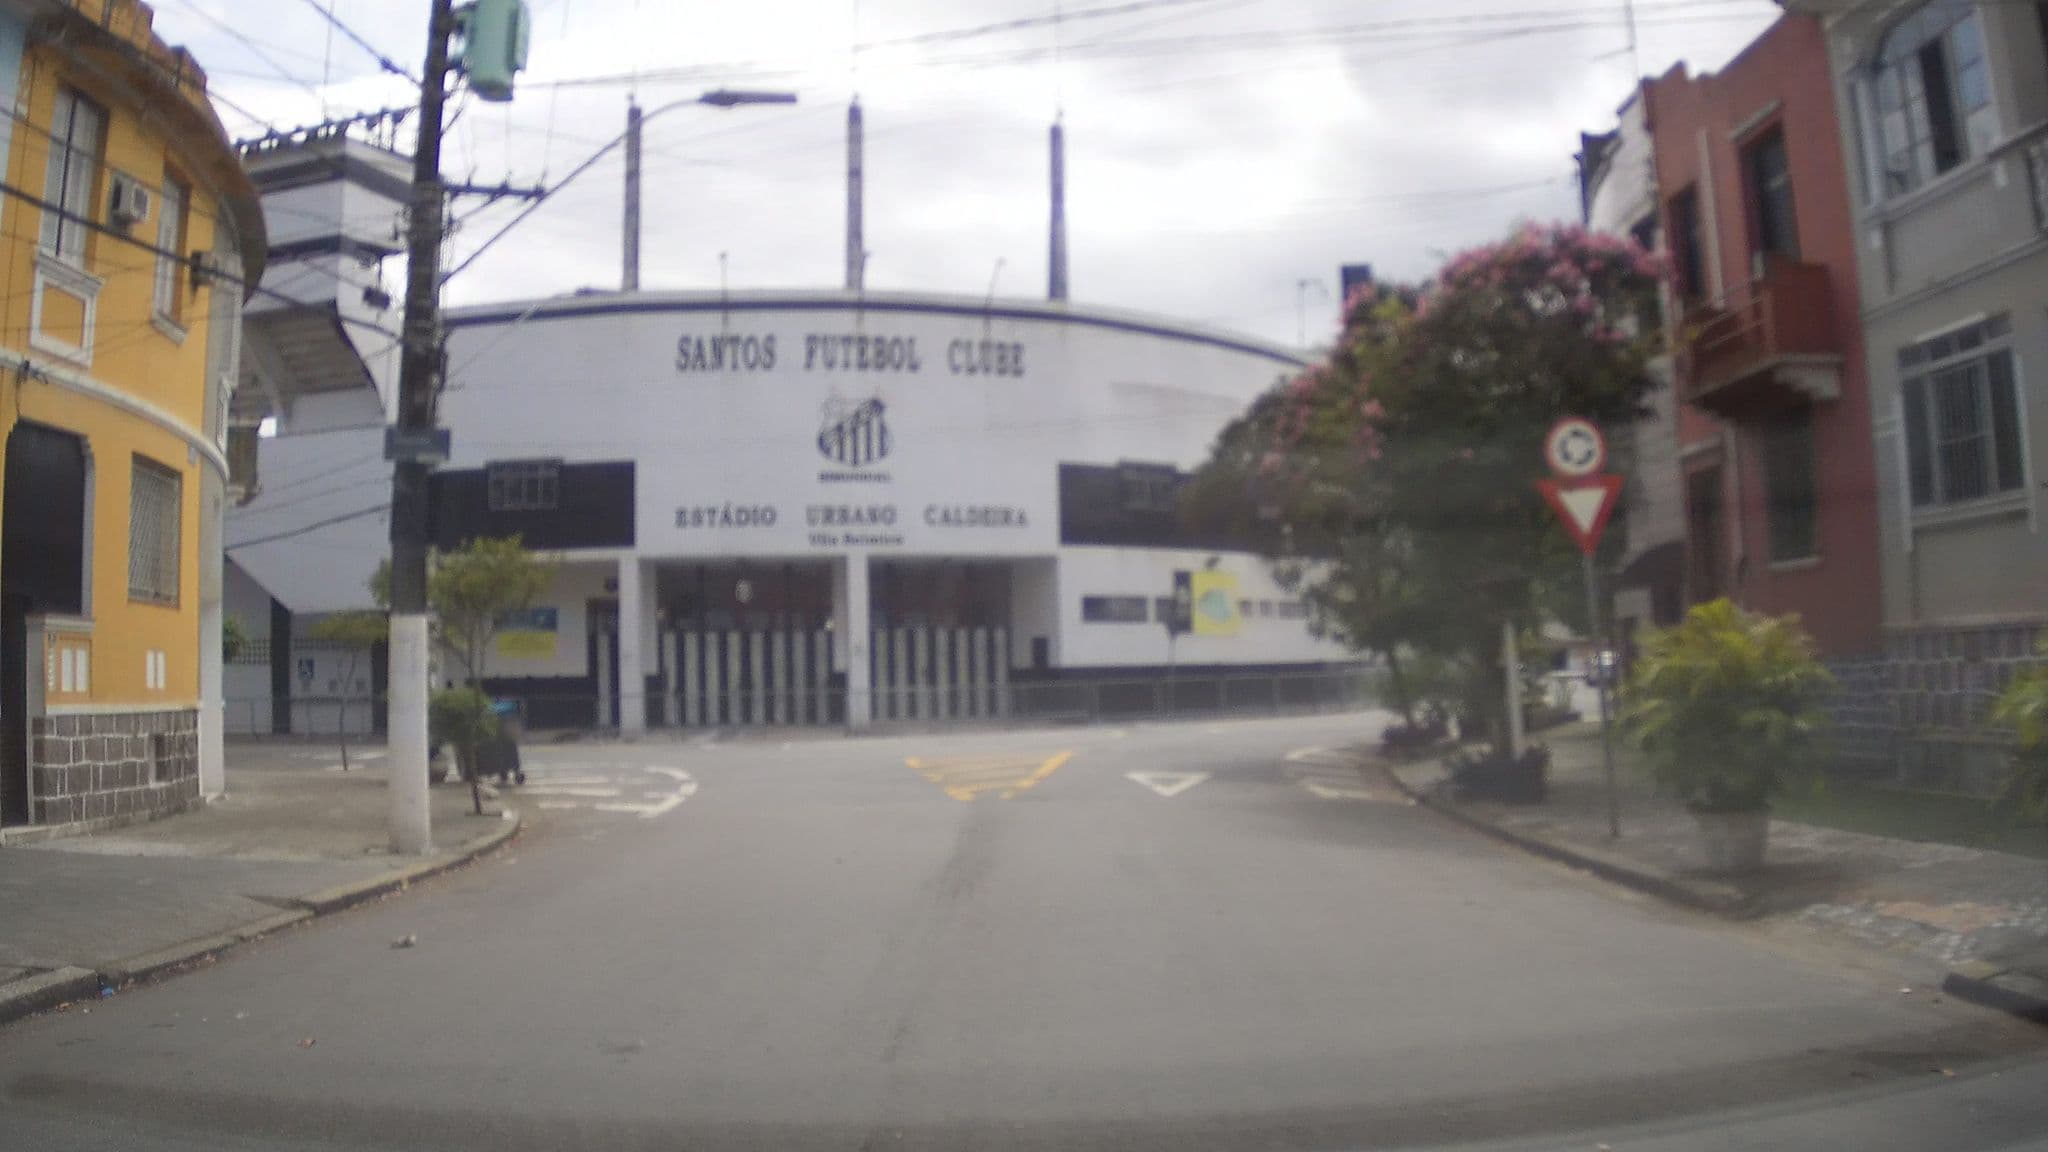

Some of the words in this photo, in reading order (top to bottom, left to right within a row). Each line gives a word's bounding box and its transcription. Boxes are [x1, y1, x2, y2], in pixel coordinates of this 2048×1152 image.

[676, 334, 778, 371] SANTOS
[804, 334, 921, 373] FUTEBOL
[947, 338, 1025, 376] CLUBE
[675, 501, 777, 528] ESTÁDIO
[806, 504, 898, 526] URBANO
[923, 504, 1029, 528] CALDEIRA
